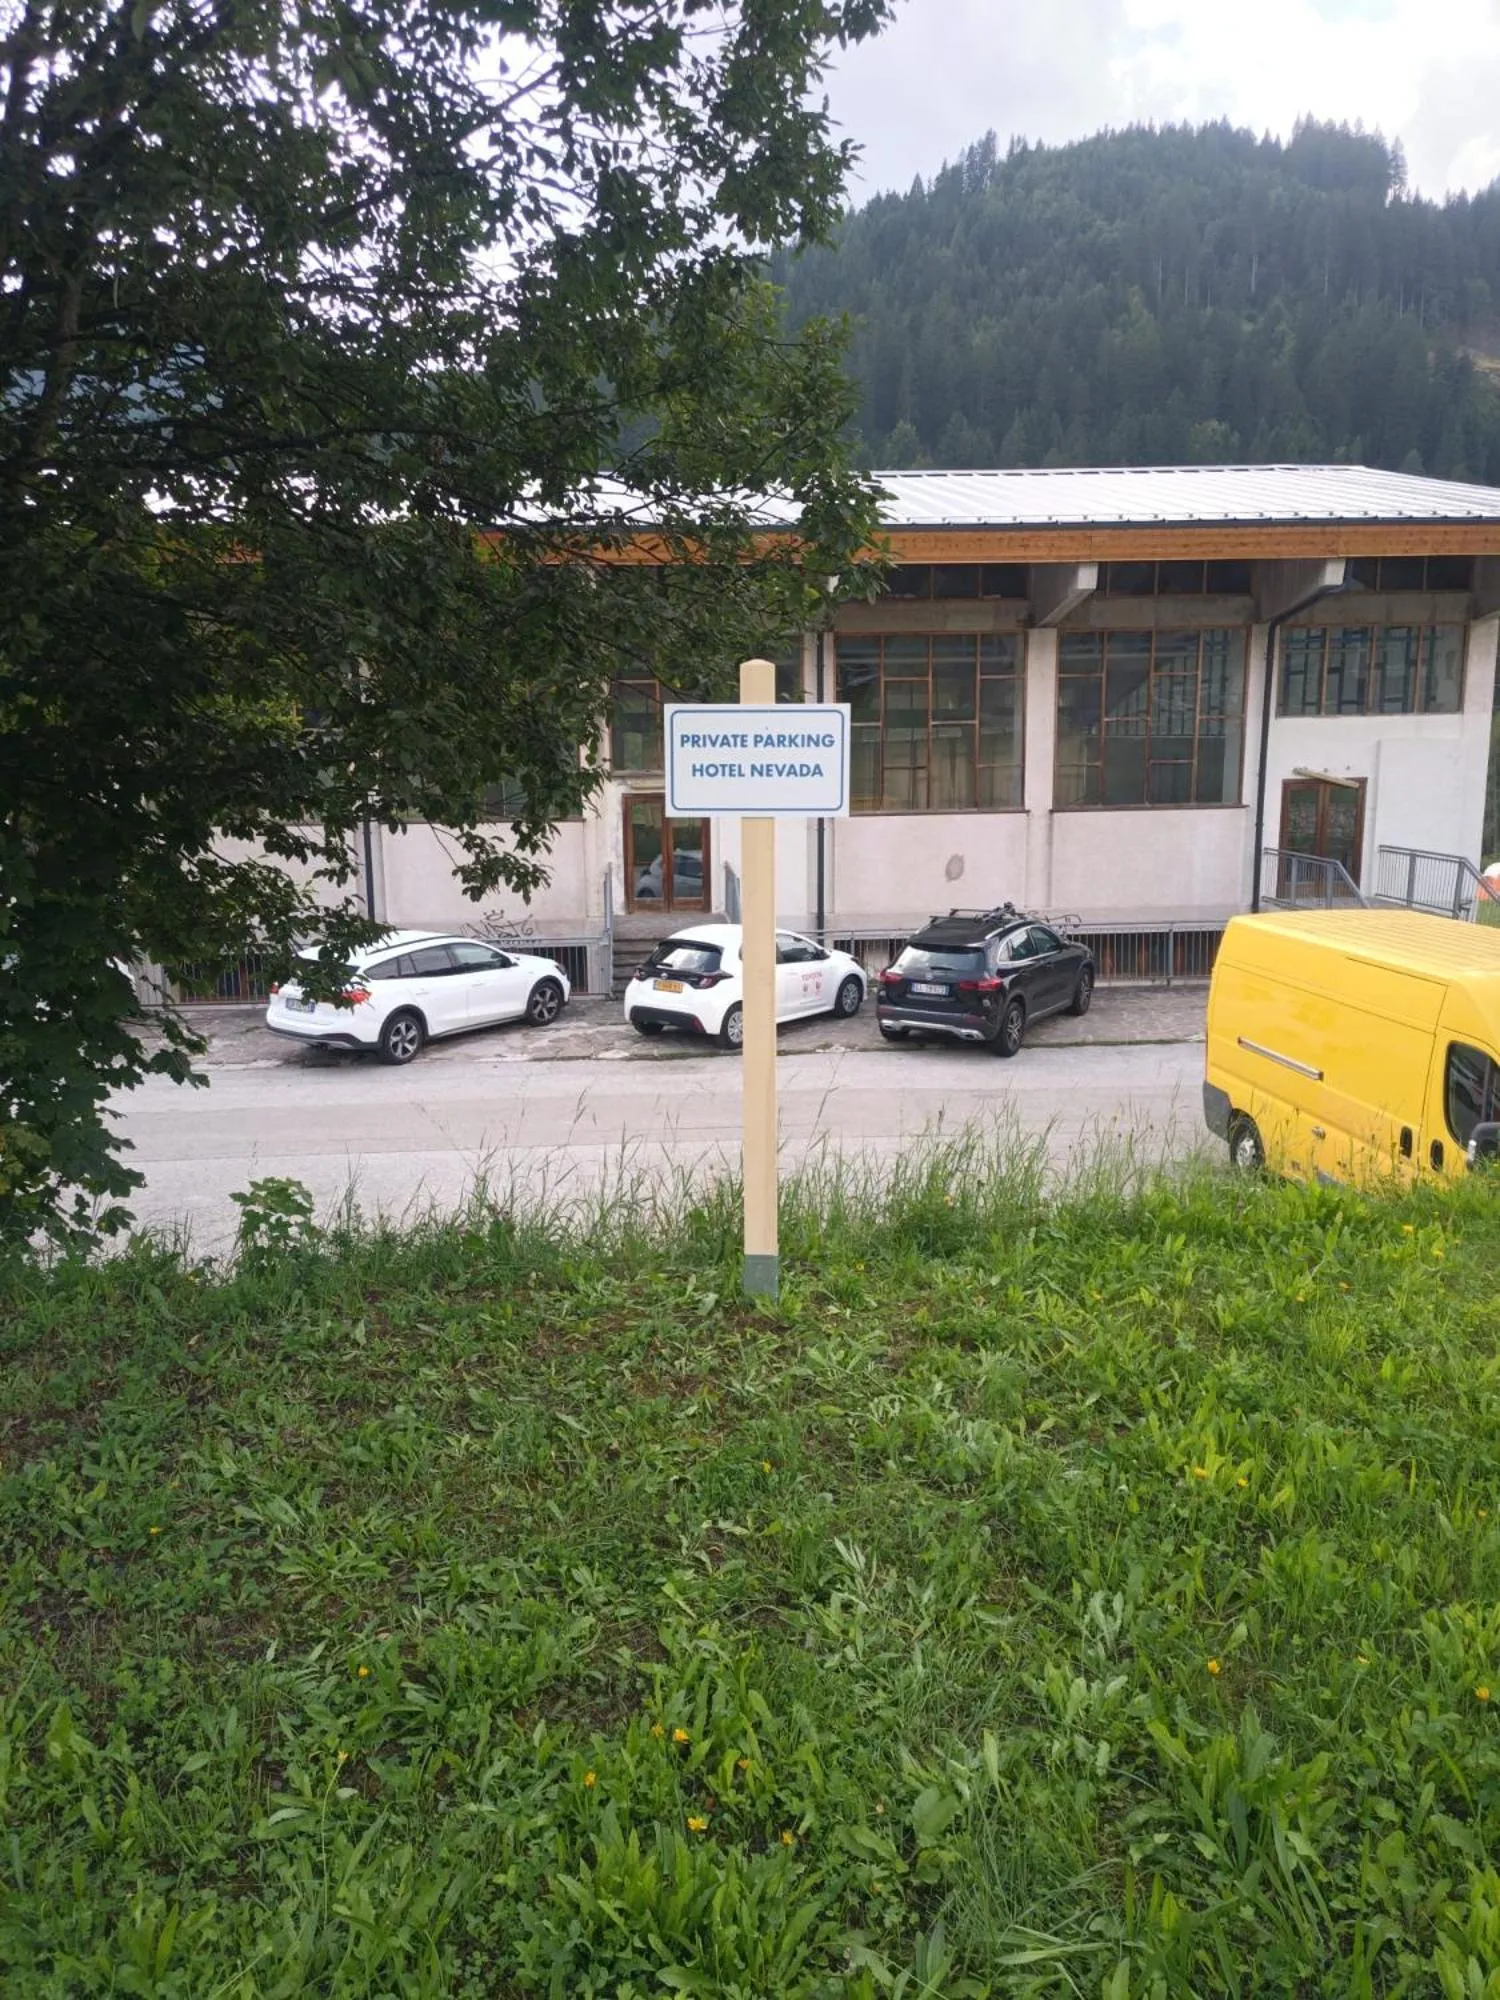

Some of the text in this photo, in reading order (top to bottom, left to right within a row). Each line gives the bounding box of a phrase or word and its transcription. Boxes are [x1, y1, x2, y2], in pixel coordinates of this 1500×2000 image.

[680, 733, 835, 748] PRIVATE PARKING
[691, 763, 824, 778] HOTEL NEVADA
